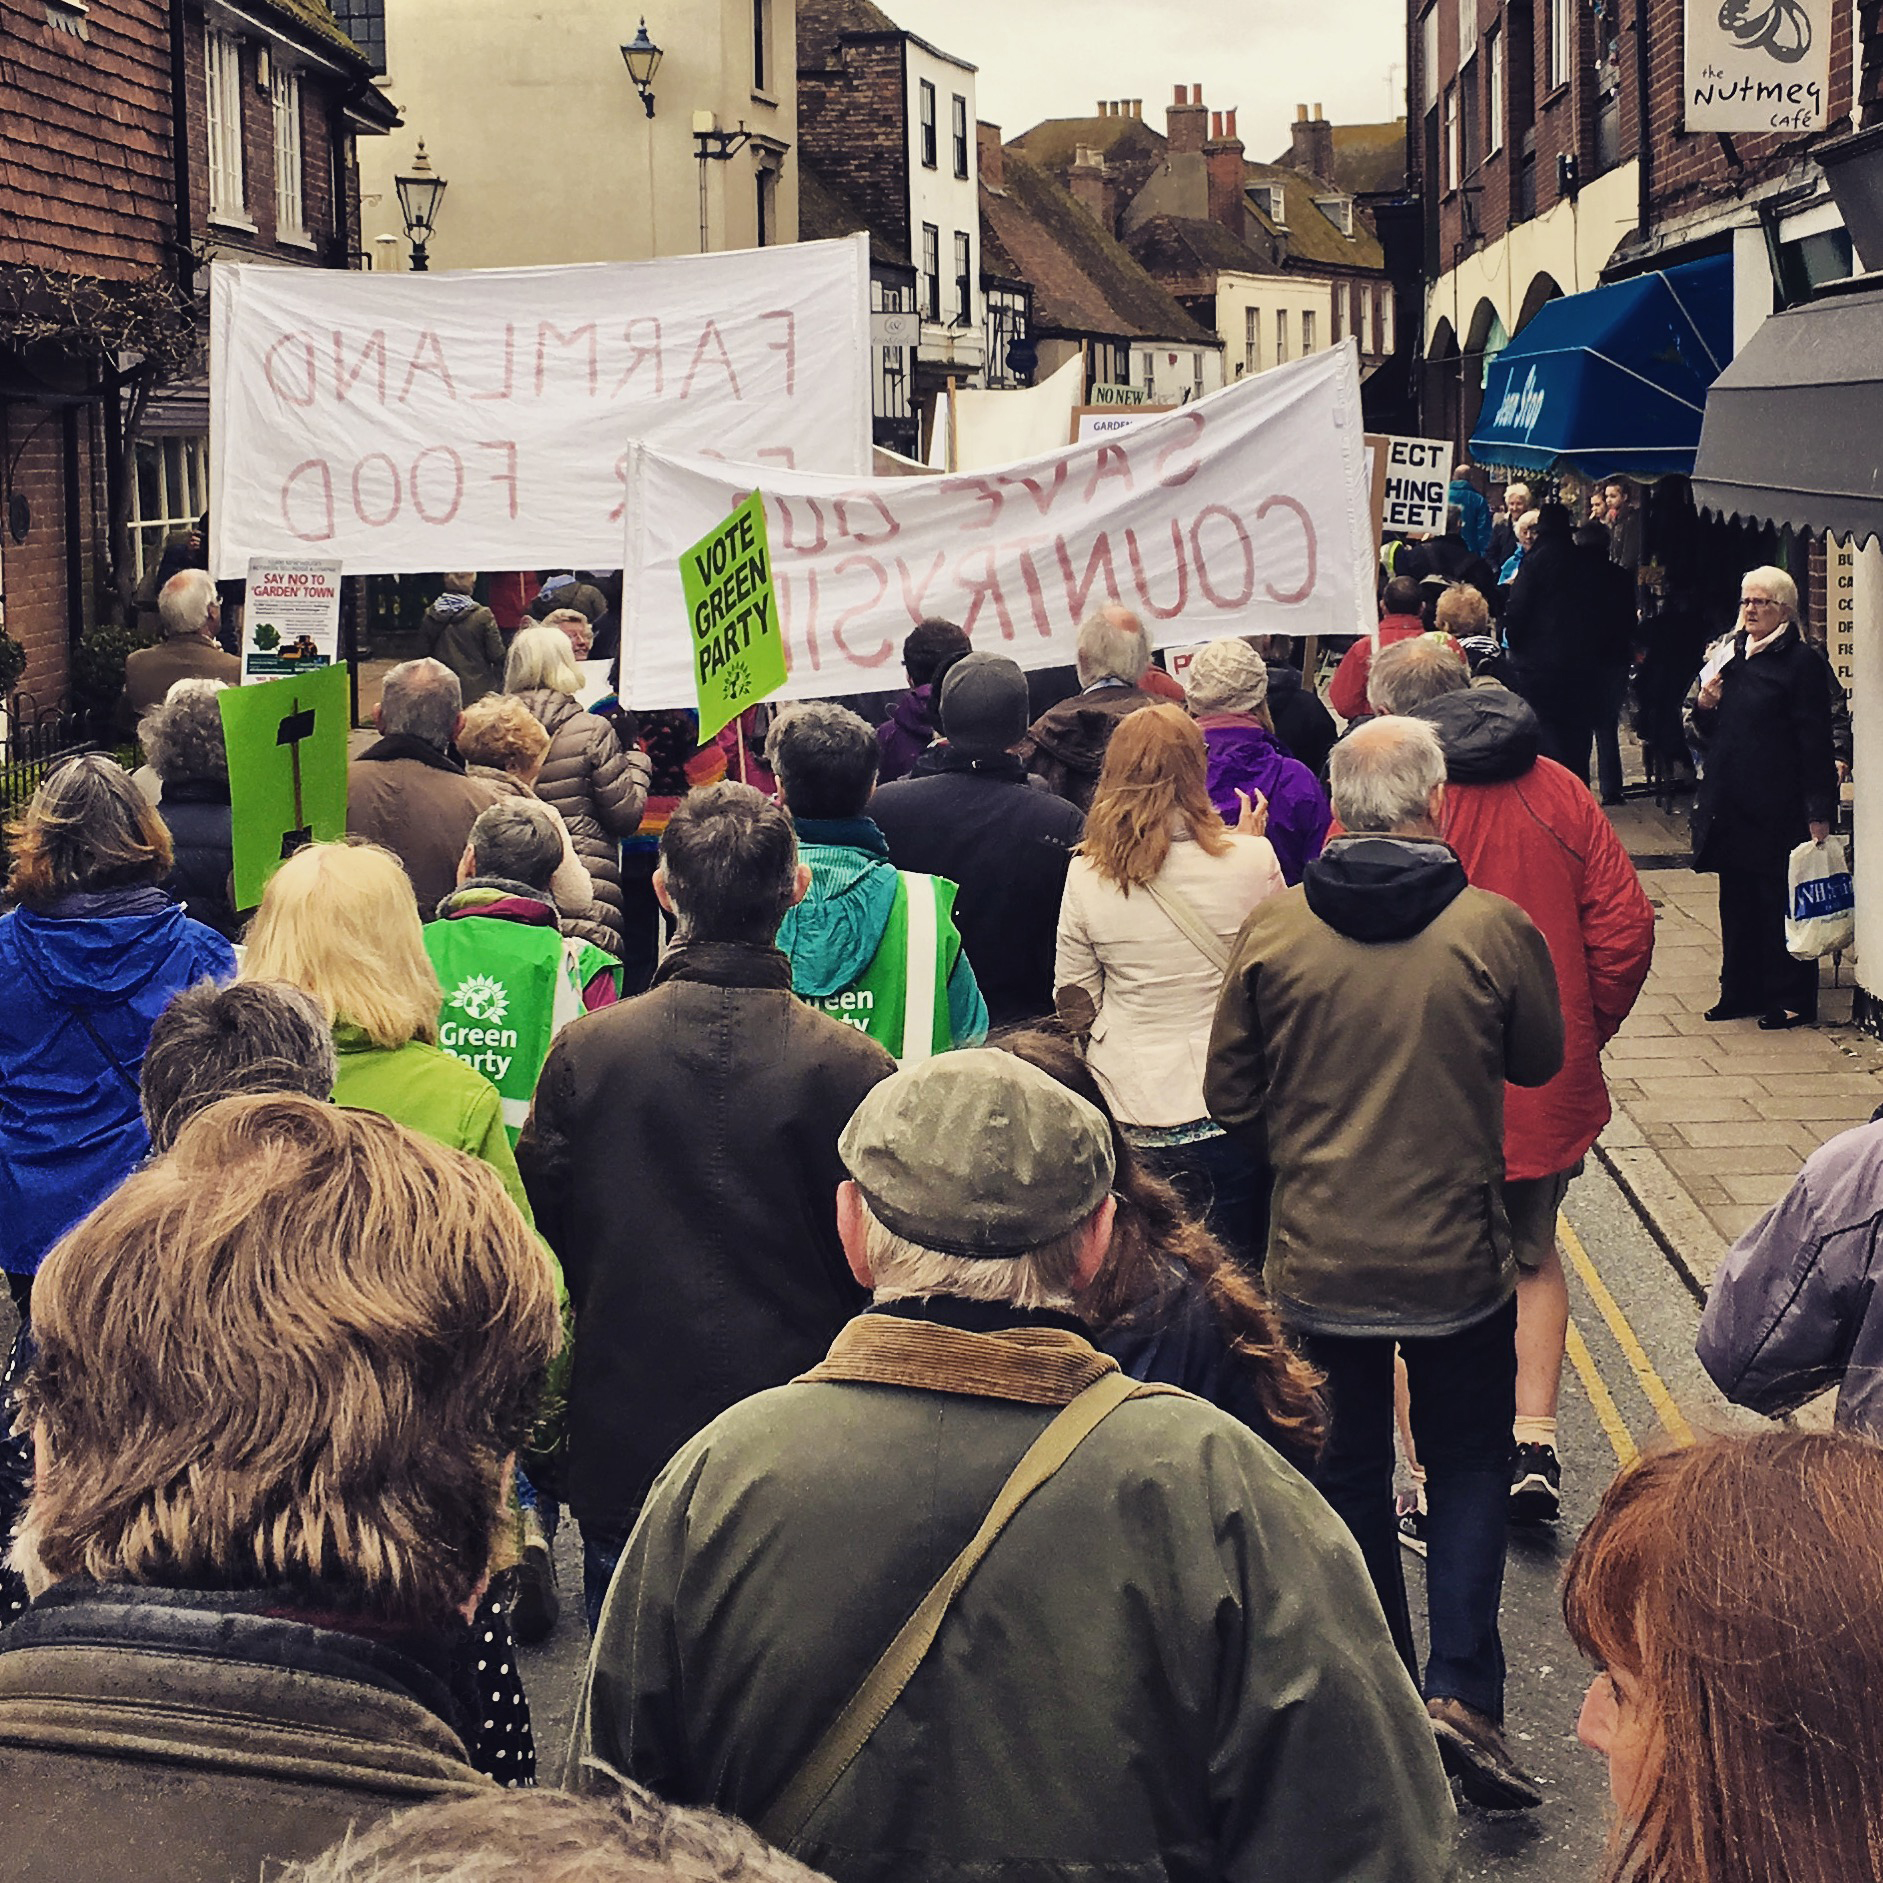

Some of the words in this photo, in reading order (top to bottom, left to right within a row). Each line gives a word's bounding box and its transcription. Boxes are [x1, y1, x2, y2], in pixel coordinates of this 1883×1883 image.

[1702, 64, 1724, 79] the
[1694, 76, 1820, 116] Nutmeg
[1096, 387, 1114, 404] NO
[1116, 390, 1144, 405] NEW
[1093, 421, 1133, 432] GARDE
[1383, 502, 1443, 527] EET
[694, 510, 755, 588] VOTE
[264, 573, 285, 584] SAY
[287, 574, 309, 585] NO
[311, 575, 325, 585] TO
[303, 587, 335, 598] TOWN
[695, 547, 767, 641] GREEN
[699, 592, 769, 686] PARTY
[440, 1022, 517, 1048] Green
